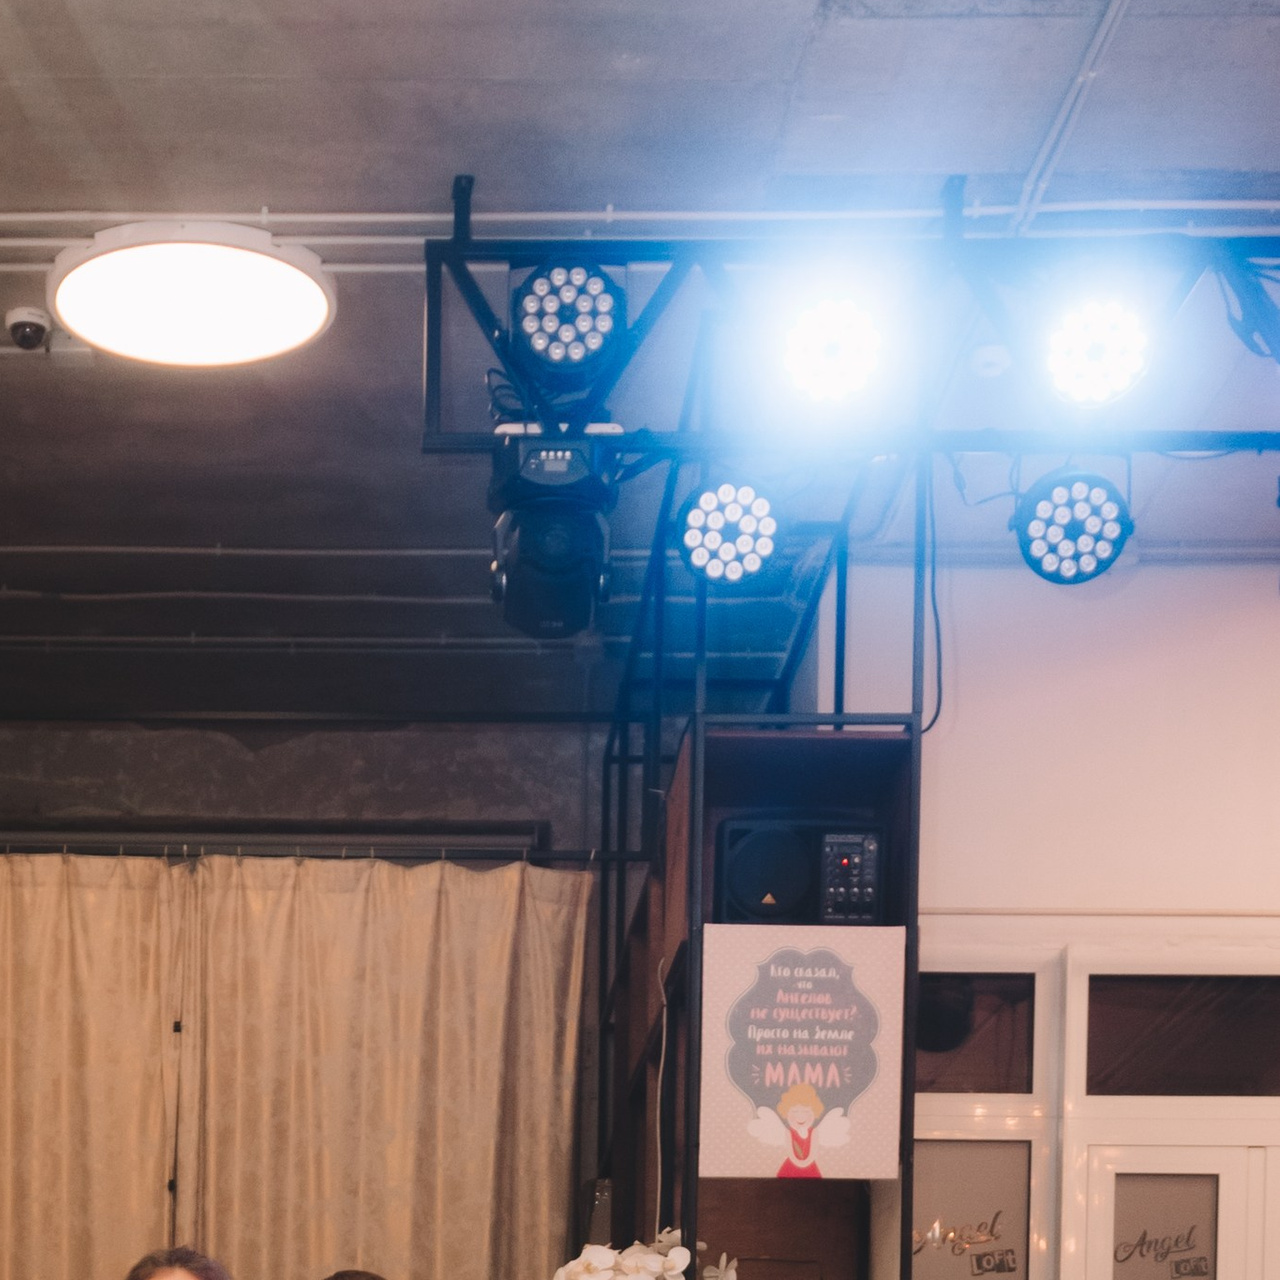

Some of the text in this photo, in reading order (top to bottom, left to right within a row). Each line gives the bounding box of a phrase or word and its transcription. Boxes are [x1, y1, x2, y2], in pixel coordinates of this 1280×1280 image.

[770, 964, 840, 980] Кто сказал,
[797, 981, 813, 989] что
[776, 989, 833, 1005] Ангелов
[750, 1007, 769, 1020] не
[747, 1025, 789, 1042] Просто
[793, 1030, 810, 1040] на
[756, 1043, 849, 1057] их называют
[765, 1061, 841, 1088] МАМА
[912, 1210, 1003, 1256] Angel
[1114, 1224, 1197, 1263] Angel
